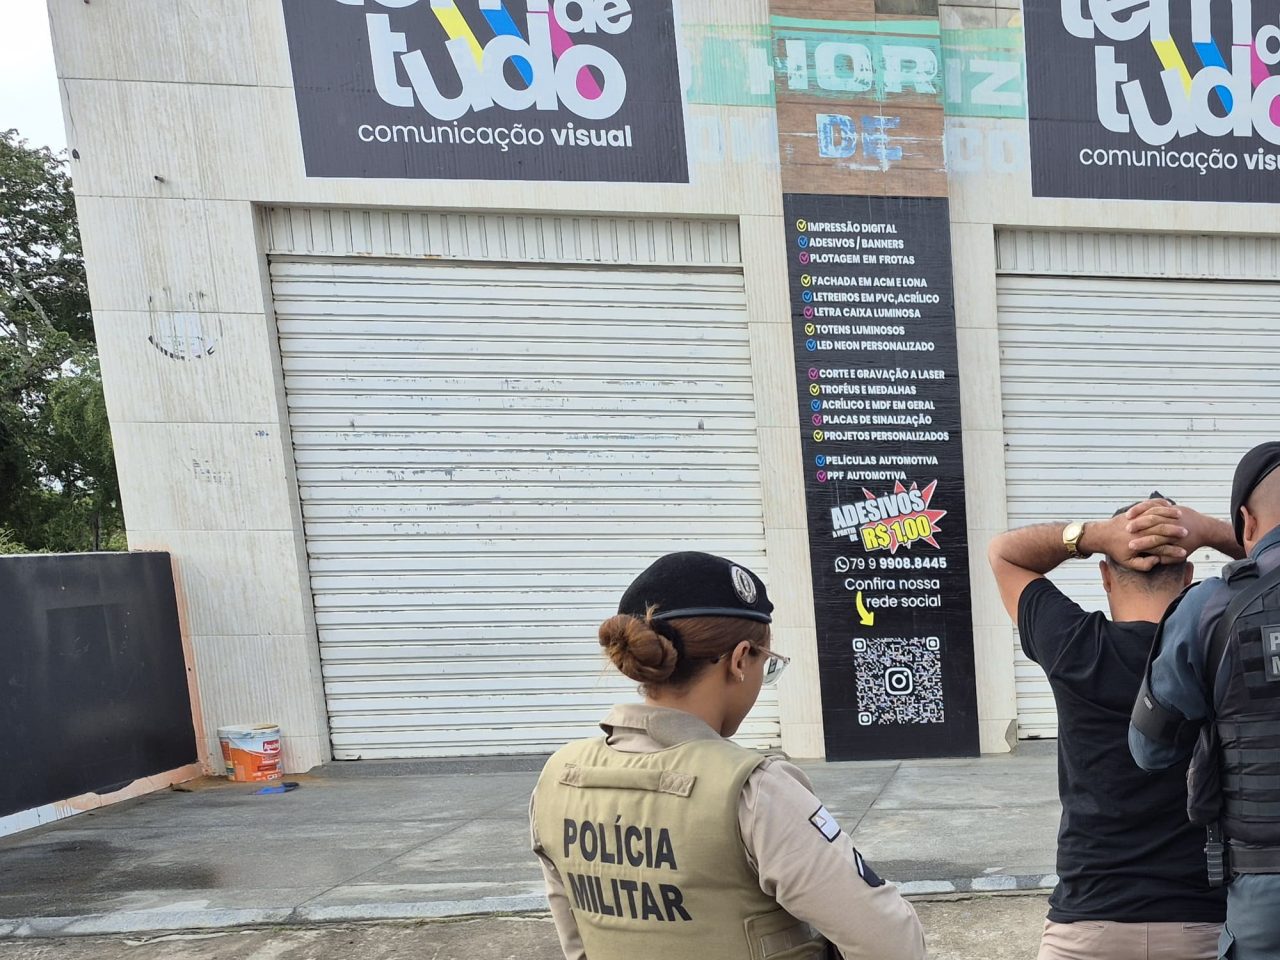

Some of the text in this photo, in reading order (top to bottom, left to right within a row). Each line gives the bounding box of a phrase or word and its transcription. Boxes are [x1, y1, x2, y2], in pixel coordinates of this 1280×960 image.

[553, 0, 633, 34] de
[365, 12, 627, 121] tudo
[358, 121, 632, 151] comunicação visual
[815, 113, 903, 160] DE
[1079, 146, 1238, 175] comunicação
[808, 221, 898, 234] IMPRESSÃO DIGITAL
[809, 238, 855, 248] ADESIVOS
[862, 239, 904, 249] BANNERS
[810, 254, 915, 265] PLOTAGEM EM FROTAS
[812, 276, 928, 288] FACHADA EM ACM E LONA
[813, 292, 860, 302] LETREIROS
[861, 293, 875, 302] EM
[814, 307, 921, 318] LETRA CAIXA LUMINOSA
[816, 325, 905, 336] TOTENS LUMINOSOS
[817, 341, 935, 351] LED NEON PERSONALIZADO
[819, 368, 945, 382] CORTE E GRAVAÇÃO A LASER
[820, 383, 916, 395] TROFÉUS E MEDALHAS
[822, 398, 936, 410] ACRÍLICO E MDF EM GERAL
[823, 414, 932, 427] PLACAS DE SINALIZAÇÃO
[824, 431, 950, 441] PROJETOS PERSONALIZADOS
[826, 454, 938, 464] PELÍCULAS AUTOMOTIVA
[828, 471, 906, 480] PPF AUTOMOTIVA
[831, 489, 925, 530] ADESIVOS
[862, 515, 932, 550] R$ 1,00
[851, 557, 947, 569] 79 9 9908.8445
[844, 577, 940, 590] Confira nossa
[866, 594, 941, 608] rede social
[563, 815, 678, 870] POLÍCIA
[567, 872, 692, 922] MILITAR
